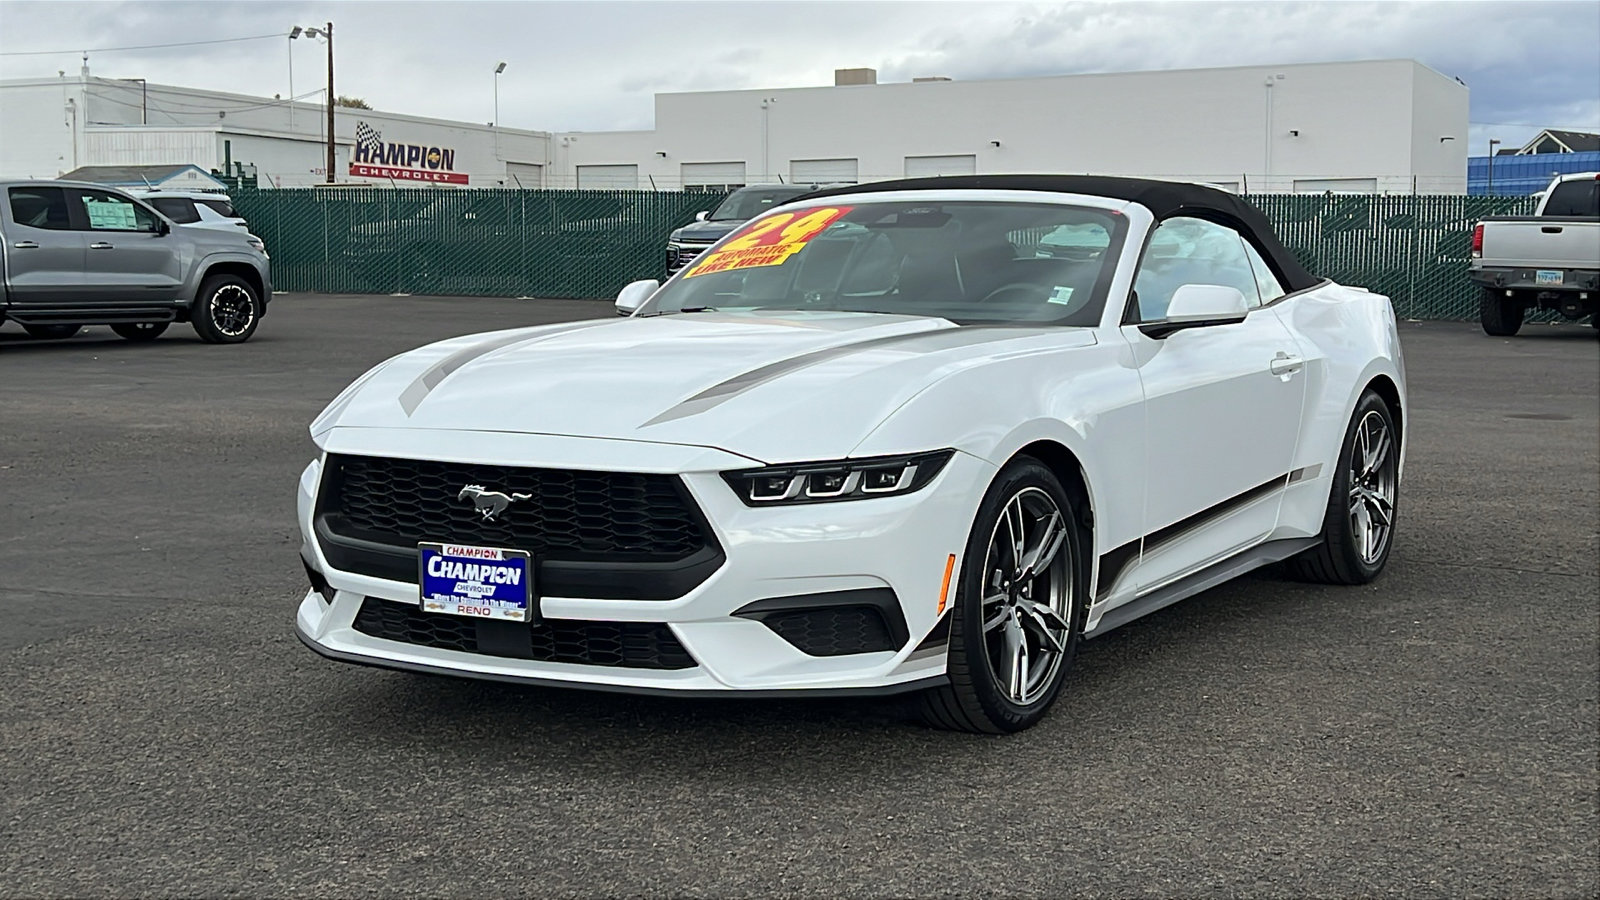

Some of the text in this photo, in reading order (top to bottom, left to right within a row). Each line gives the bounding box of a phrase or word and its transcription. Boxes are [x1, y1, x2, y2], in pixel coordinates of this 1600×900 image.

[359, 167, 450, 181] CHEVROLET
[718, 208, 840, 252] 24
[711, 244, 792, 263] AUTOMATIC
[690, 254, 783, 276] LIKE NEW
[446, 546, 498, 559] CHAMPION
[427, 555, 522, 585] CHAMPION
[456, 584, 493, 594] CHEVROLET
[457, 605, 491, 616] RENO
